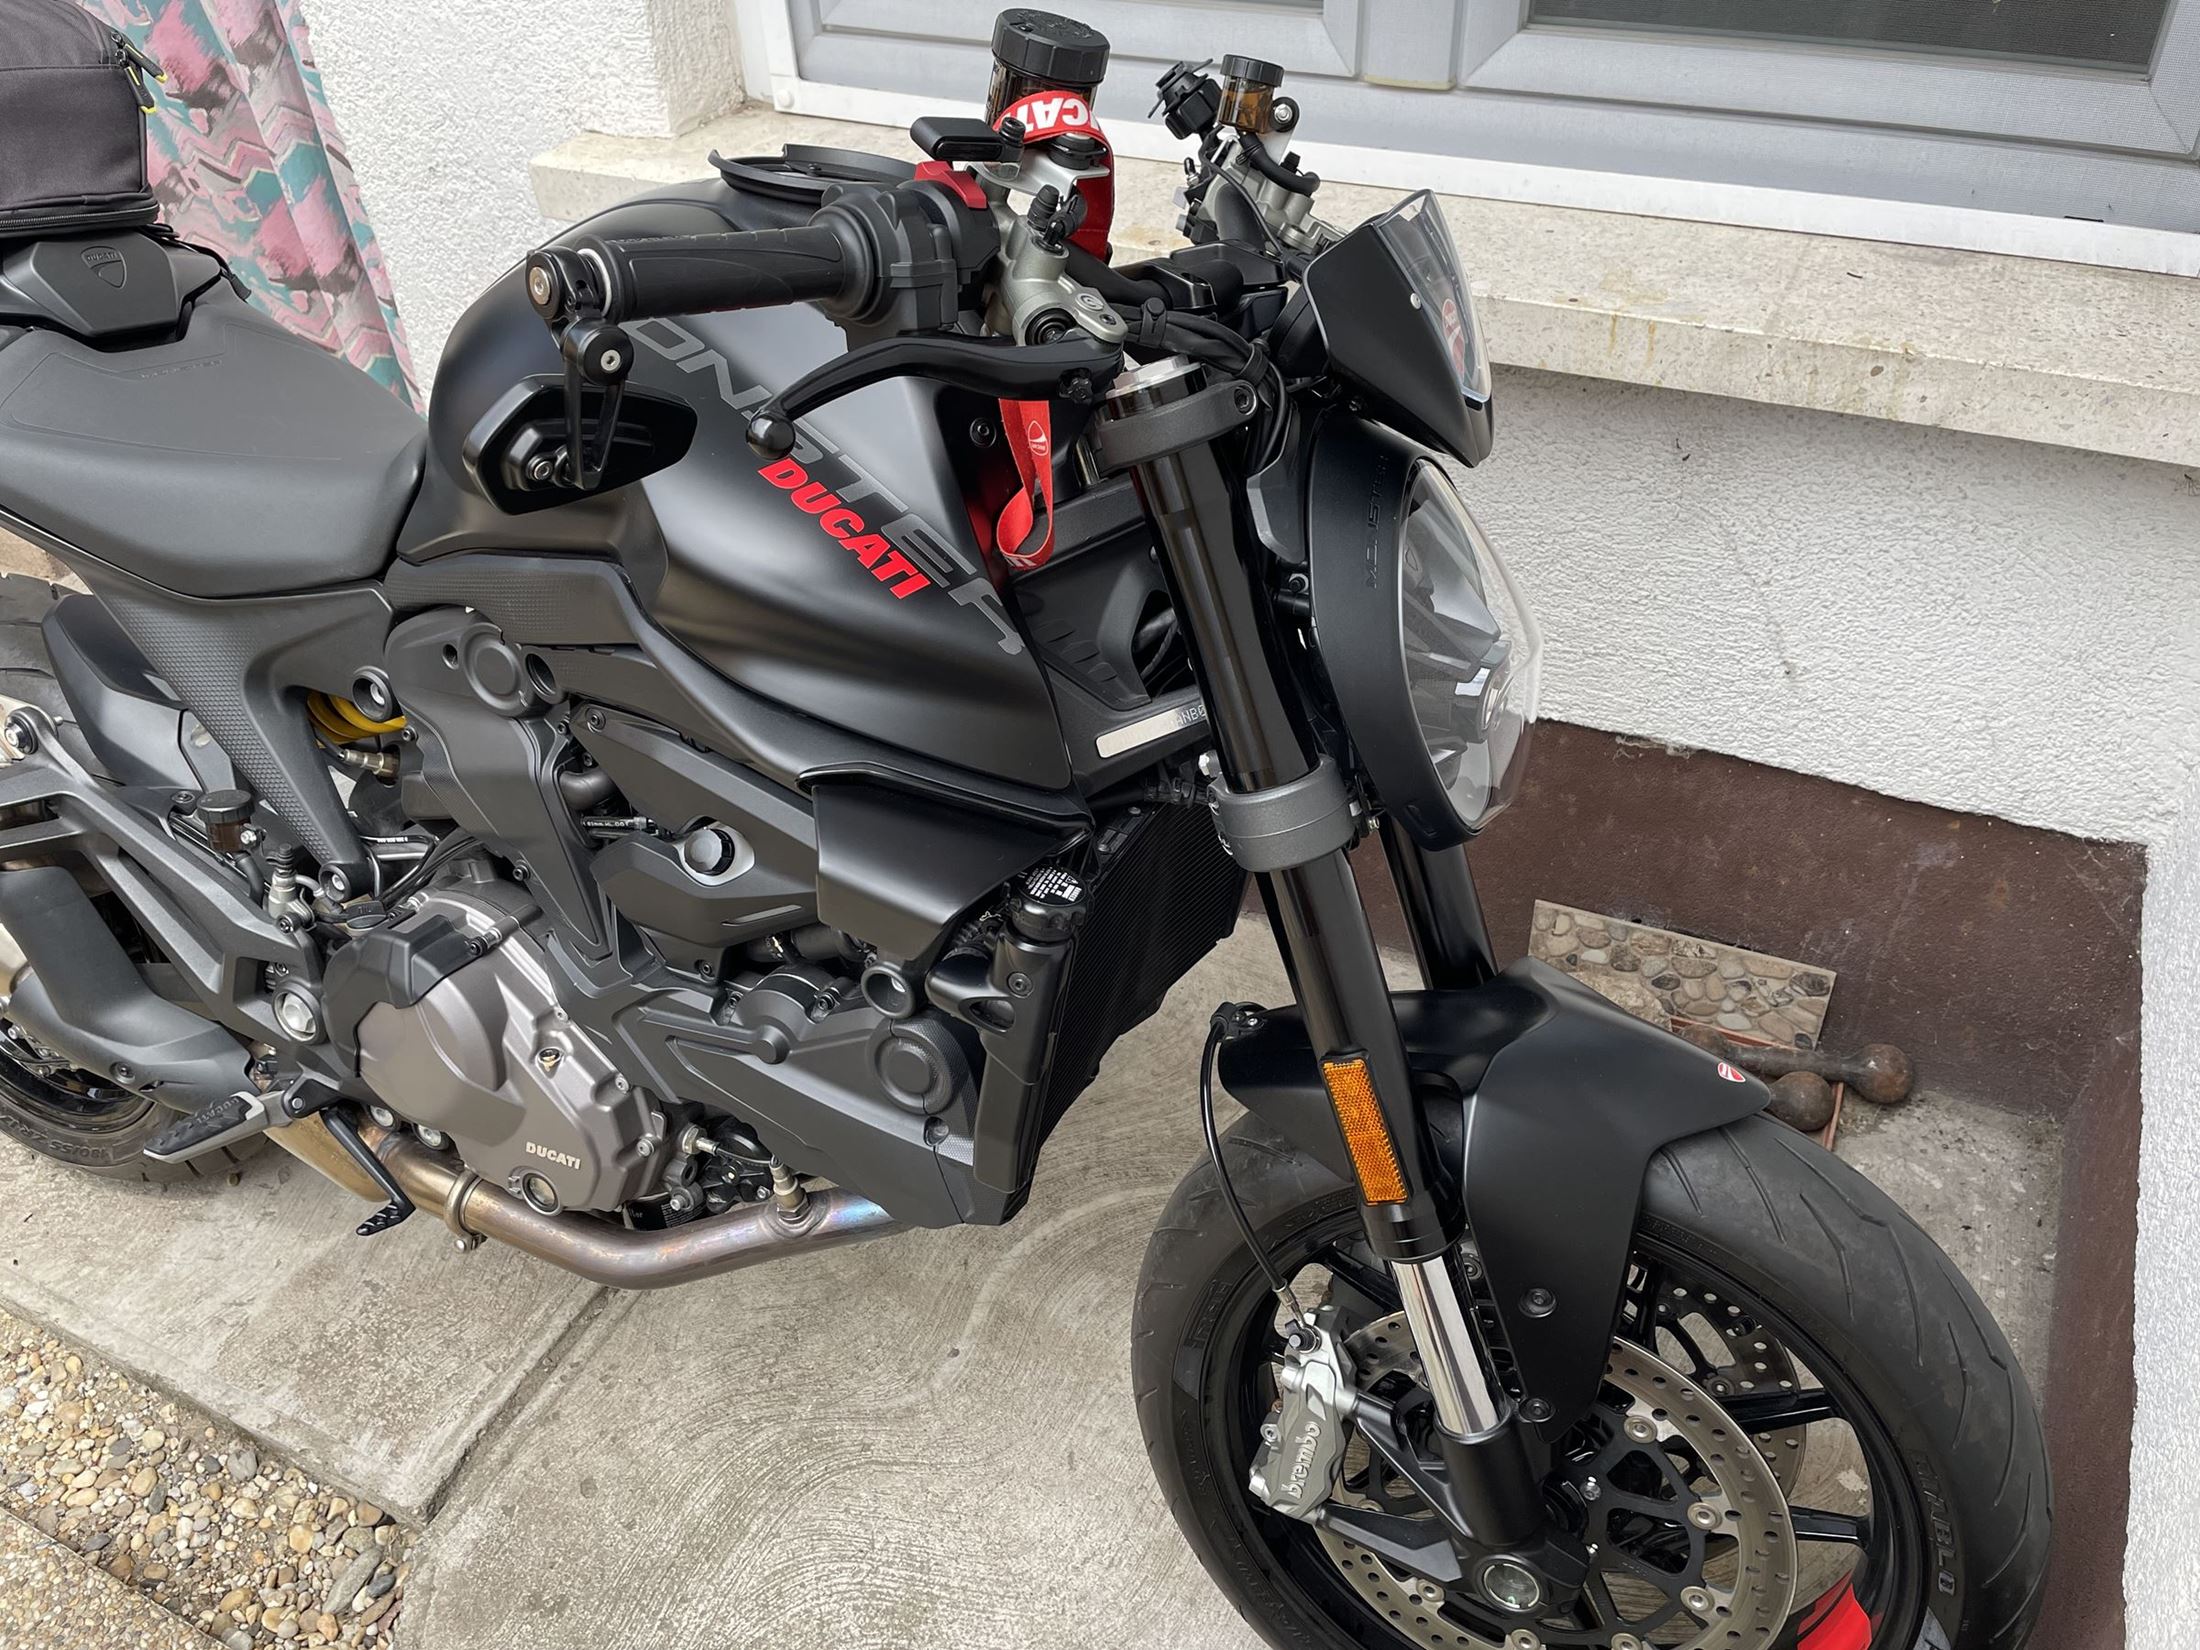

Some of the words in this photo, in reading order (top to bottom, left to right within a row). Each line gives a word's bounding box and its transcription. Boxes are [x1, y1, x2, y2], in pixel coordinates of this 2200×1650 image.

[757, 457, 931, 600] DUCATI
[525, 1141, 581, 1170] DUCATI
[1281, 1421, 1321, 1499] brembo
